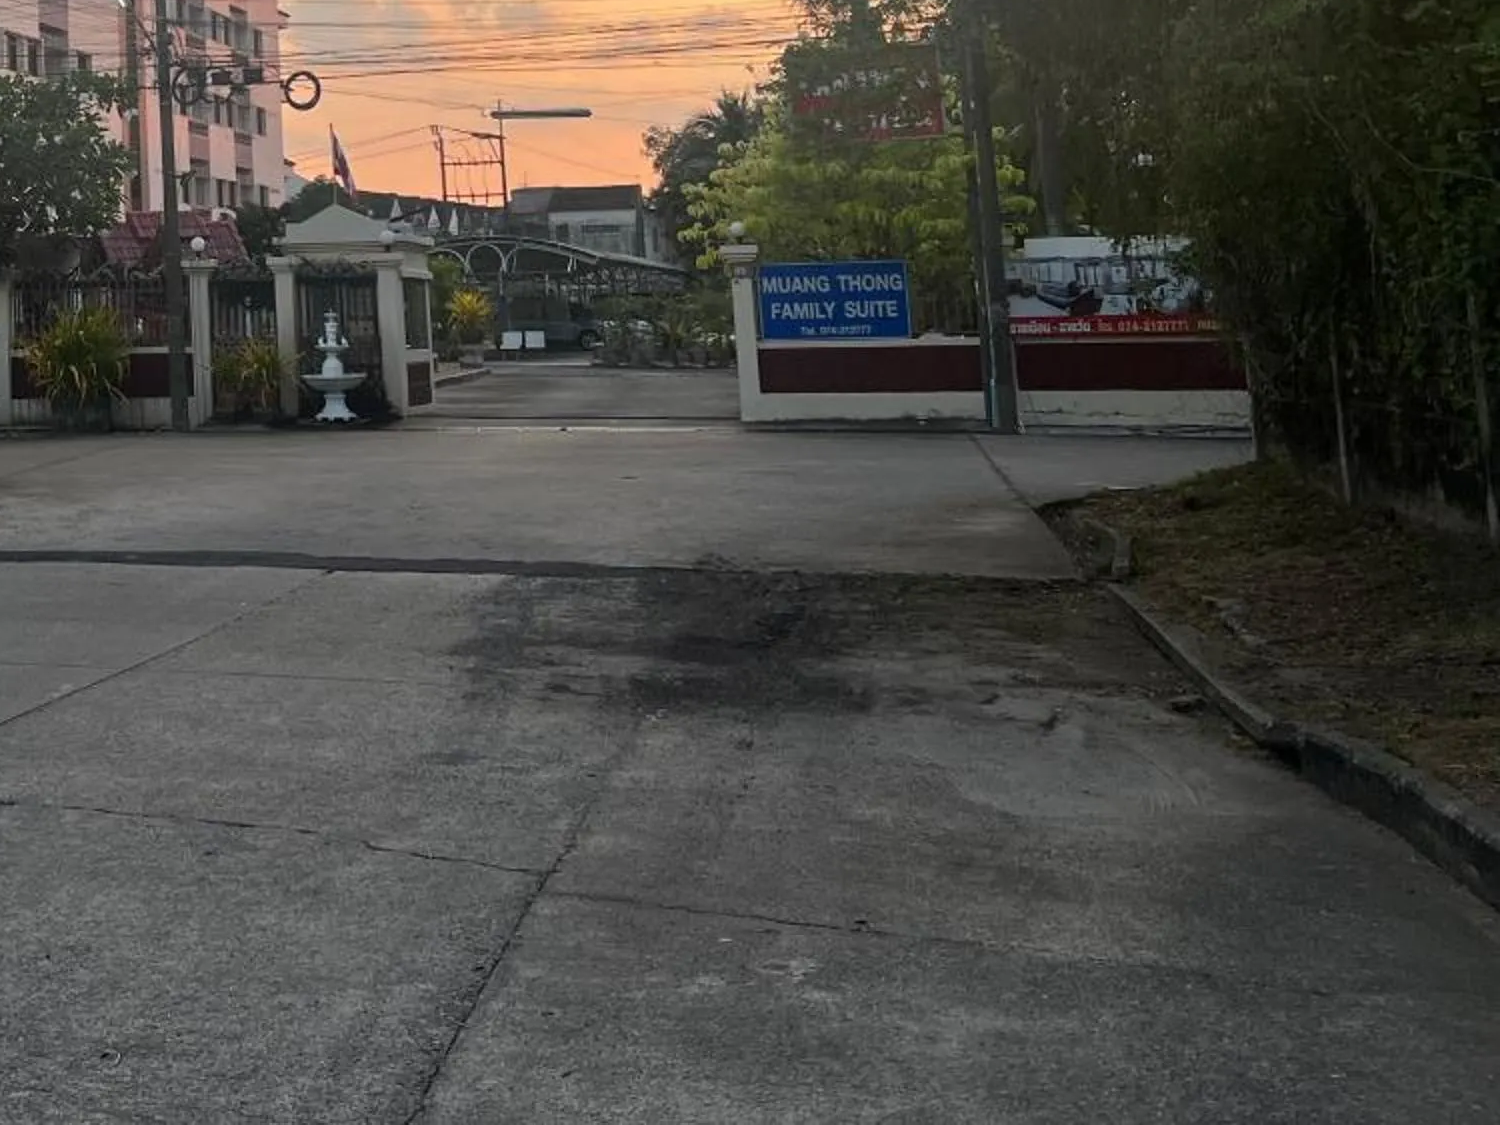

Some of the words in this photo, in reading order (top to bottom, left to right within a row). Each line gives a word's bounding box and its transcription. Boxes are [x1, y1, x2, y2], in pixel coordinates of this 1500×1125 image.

[762, 276, 831, 294] MUANG
[836, 274, 903, 292] THONG
[771, 300, 836, 320] FAMILY
[844, 300, 899, 318] SUITE
